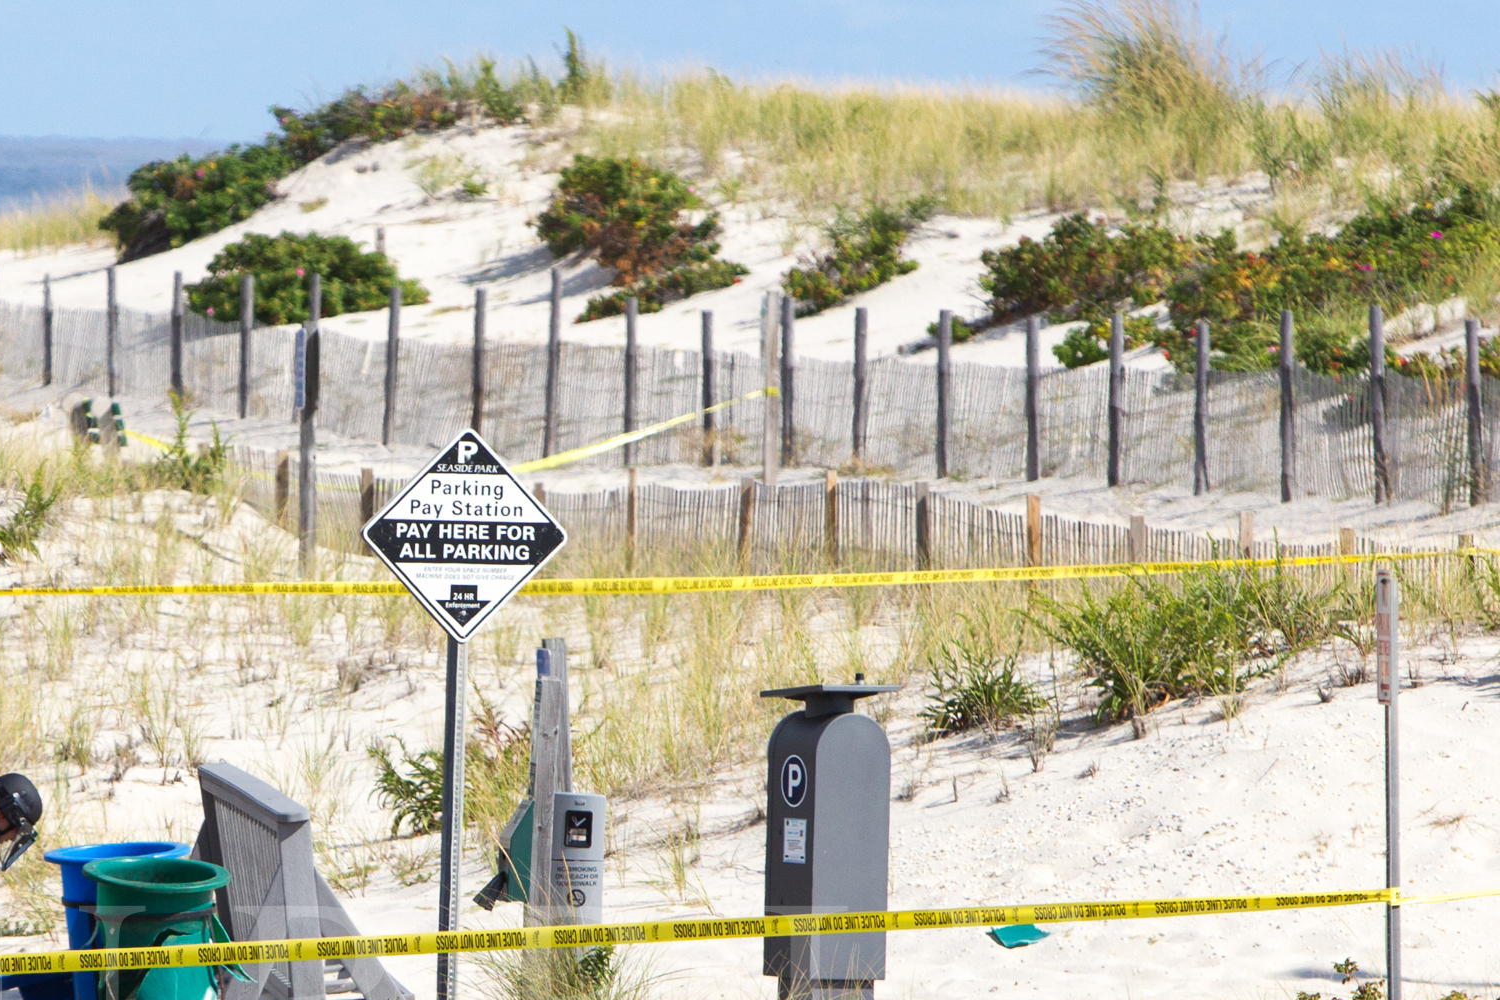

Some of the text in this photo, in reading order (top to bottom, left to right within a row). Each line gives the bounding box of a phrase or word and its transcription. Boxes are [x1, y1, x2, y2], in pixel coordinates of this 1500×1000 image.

[457, 441, 478, 464] P
[436, 464, 499, 473] SEASIDE PARK
[431, 479, 504, 500] Parking
[410, 499, 523, 518] Pay Station
[396, 523, 535, 541] PAY HERE FOR
[399, 543, 530, 561] ALL PARKING
[592, 581, 652, 591] POLICE LINE DO NOT CROSS
[751, 576, 813, 587] POLICE LINE DO NOT CROSS
[453, 592, 462, 600] 24
[788, 763, 802, 798] P
[793, 914, 885, 932] POLICE LINE DO NOT CROSS
[913, 909, 1005, 925] POLICE LINE DO NOT CROSS
[553, 925, 645, 944] POLICE LINE DO NOT CROSS
[673, 919, 765, 938] POLICE LINE DO NOT CROSS
[317, 937, 408, 956] POLICE LINE DO NOT CROSS
[435, 931, 526, 950] POLICE LINE DO NOT CROSS
[79, 949, 169, 968] POLICE LINE DO NOT CROSS
[198, 944, 288, 962] POLICE LINE DO NOT CROSS
[0, 957, 9, 972] DO
[11, 957, 25, 971] LINE
[28, 955, 51, 970] POLICE
